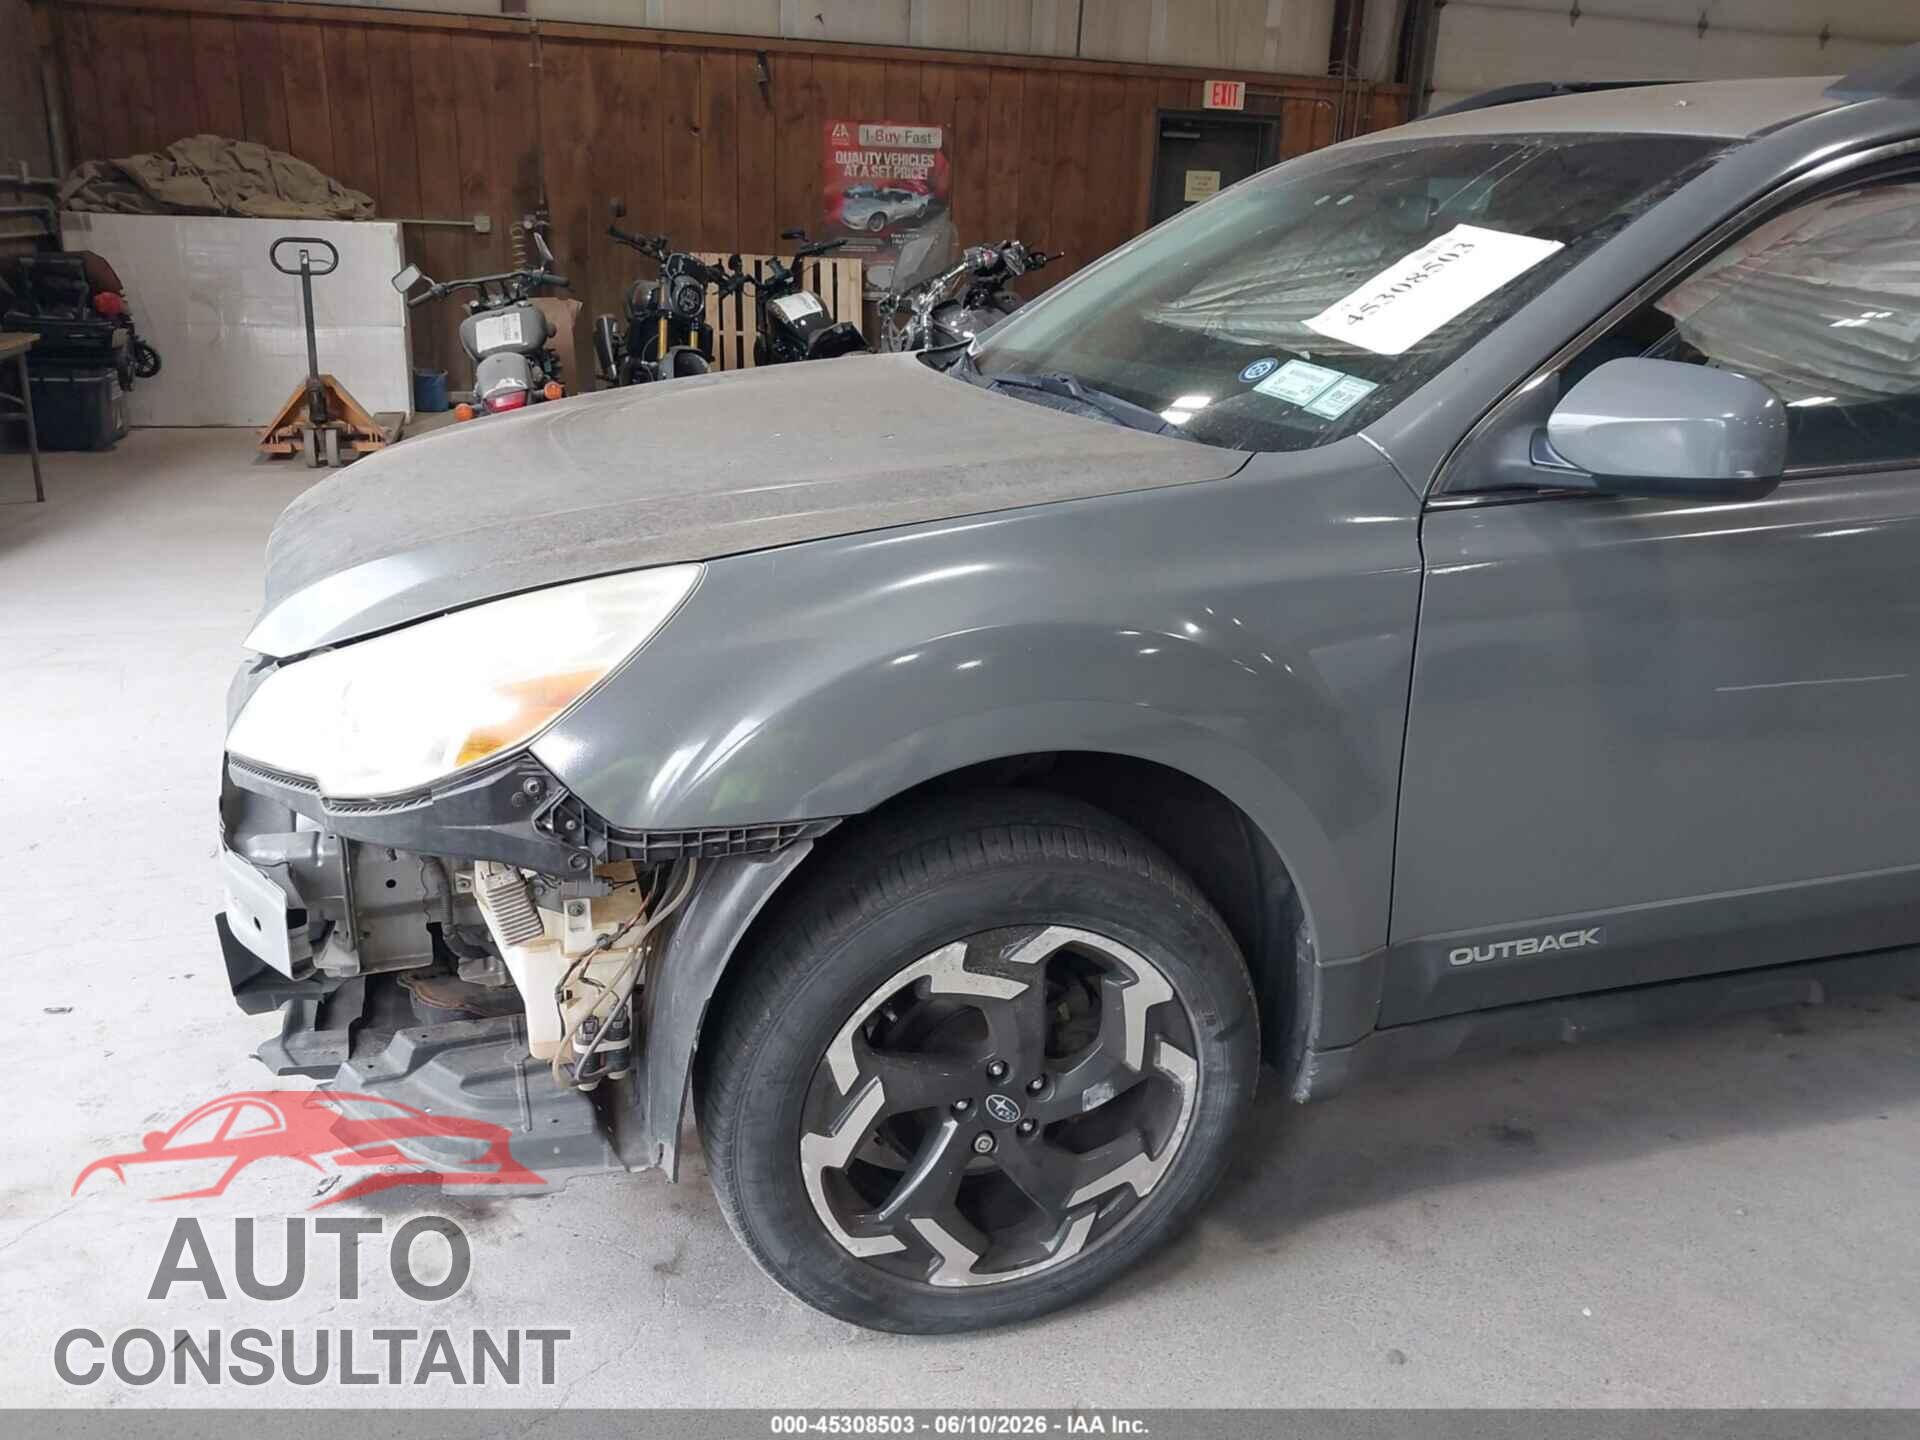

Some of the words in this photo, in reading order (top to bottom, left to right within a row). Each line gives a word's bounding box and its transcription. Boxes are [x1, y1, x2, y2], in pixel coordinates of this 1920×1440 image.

[1212, 82, 1238, 107] EXIT
[904, 130, 932, 144] Fast
[835, 150, 881, 166] QUALITY
[882, 152, 935, 168] VEHICLES
[844, 165, 859, 177] AT
[860, 165, 870, 177] A
[871, 166, 892, 178] SET
[893, 166, 928, 180] PRICE!
[1346, 243, 1476, 326] 45308503
[1449, 927, 1601, 967] OUTBACK
